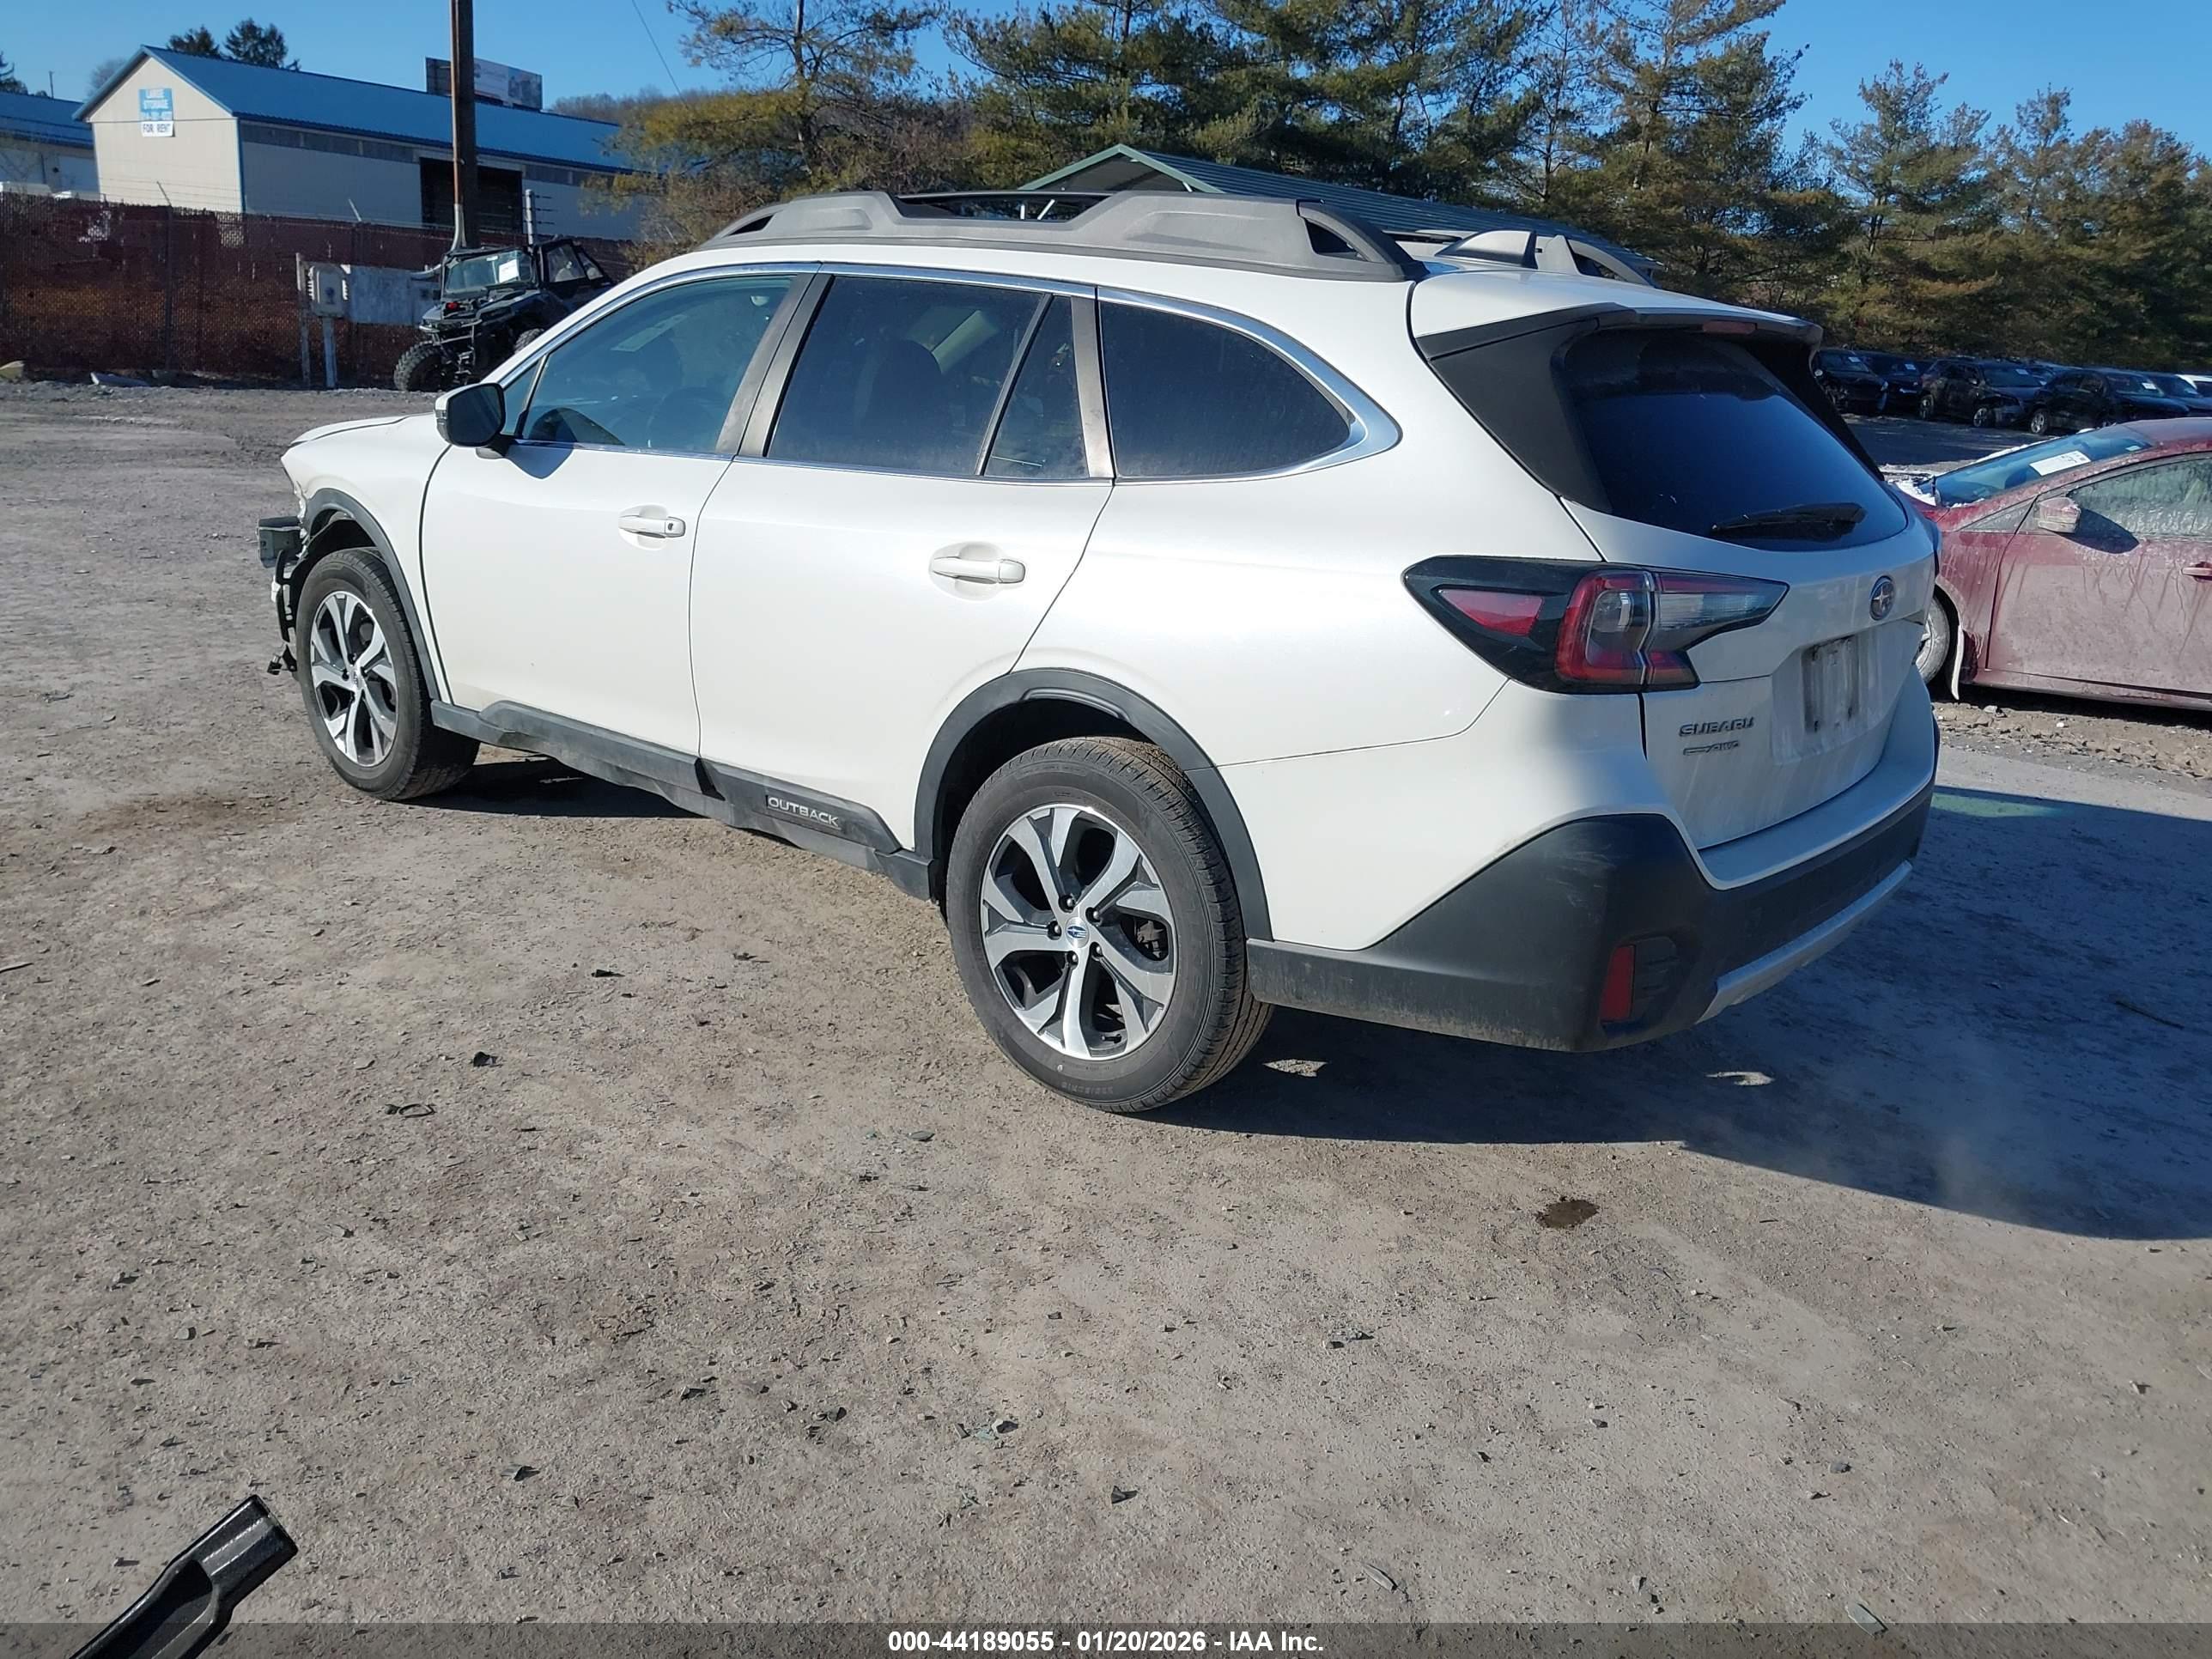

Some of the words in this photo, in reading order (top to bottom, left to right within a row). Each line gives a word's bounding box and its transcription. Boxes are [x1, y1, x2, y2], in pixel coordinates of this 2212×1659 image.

[143, 123, 154, 133] FOR
[156, 123, 171, 133] RENT
[1679, 716, 1754, 737] SUBARU
[768, 797, 839, 828] OUTBACK
